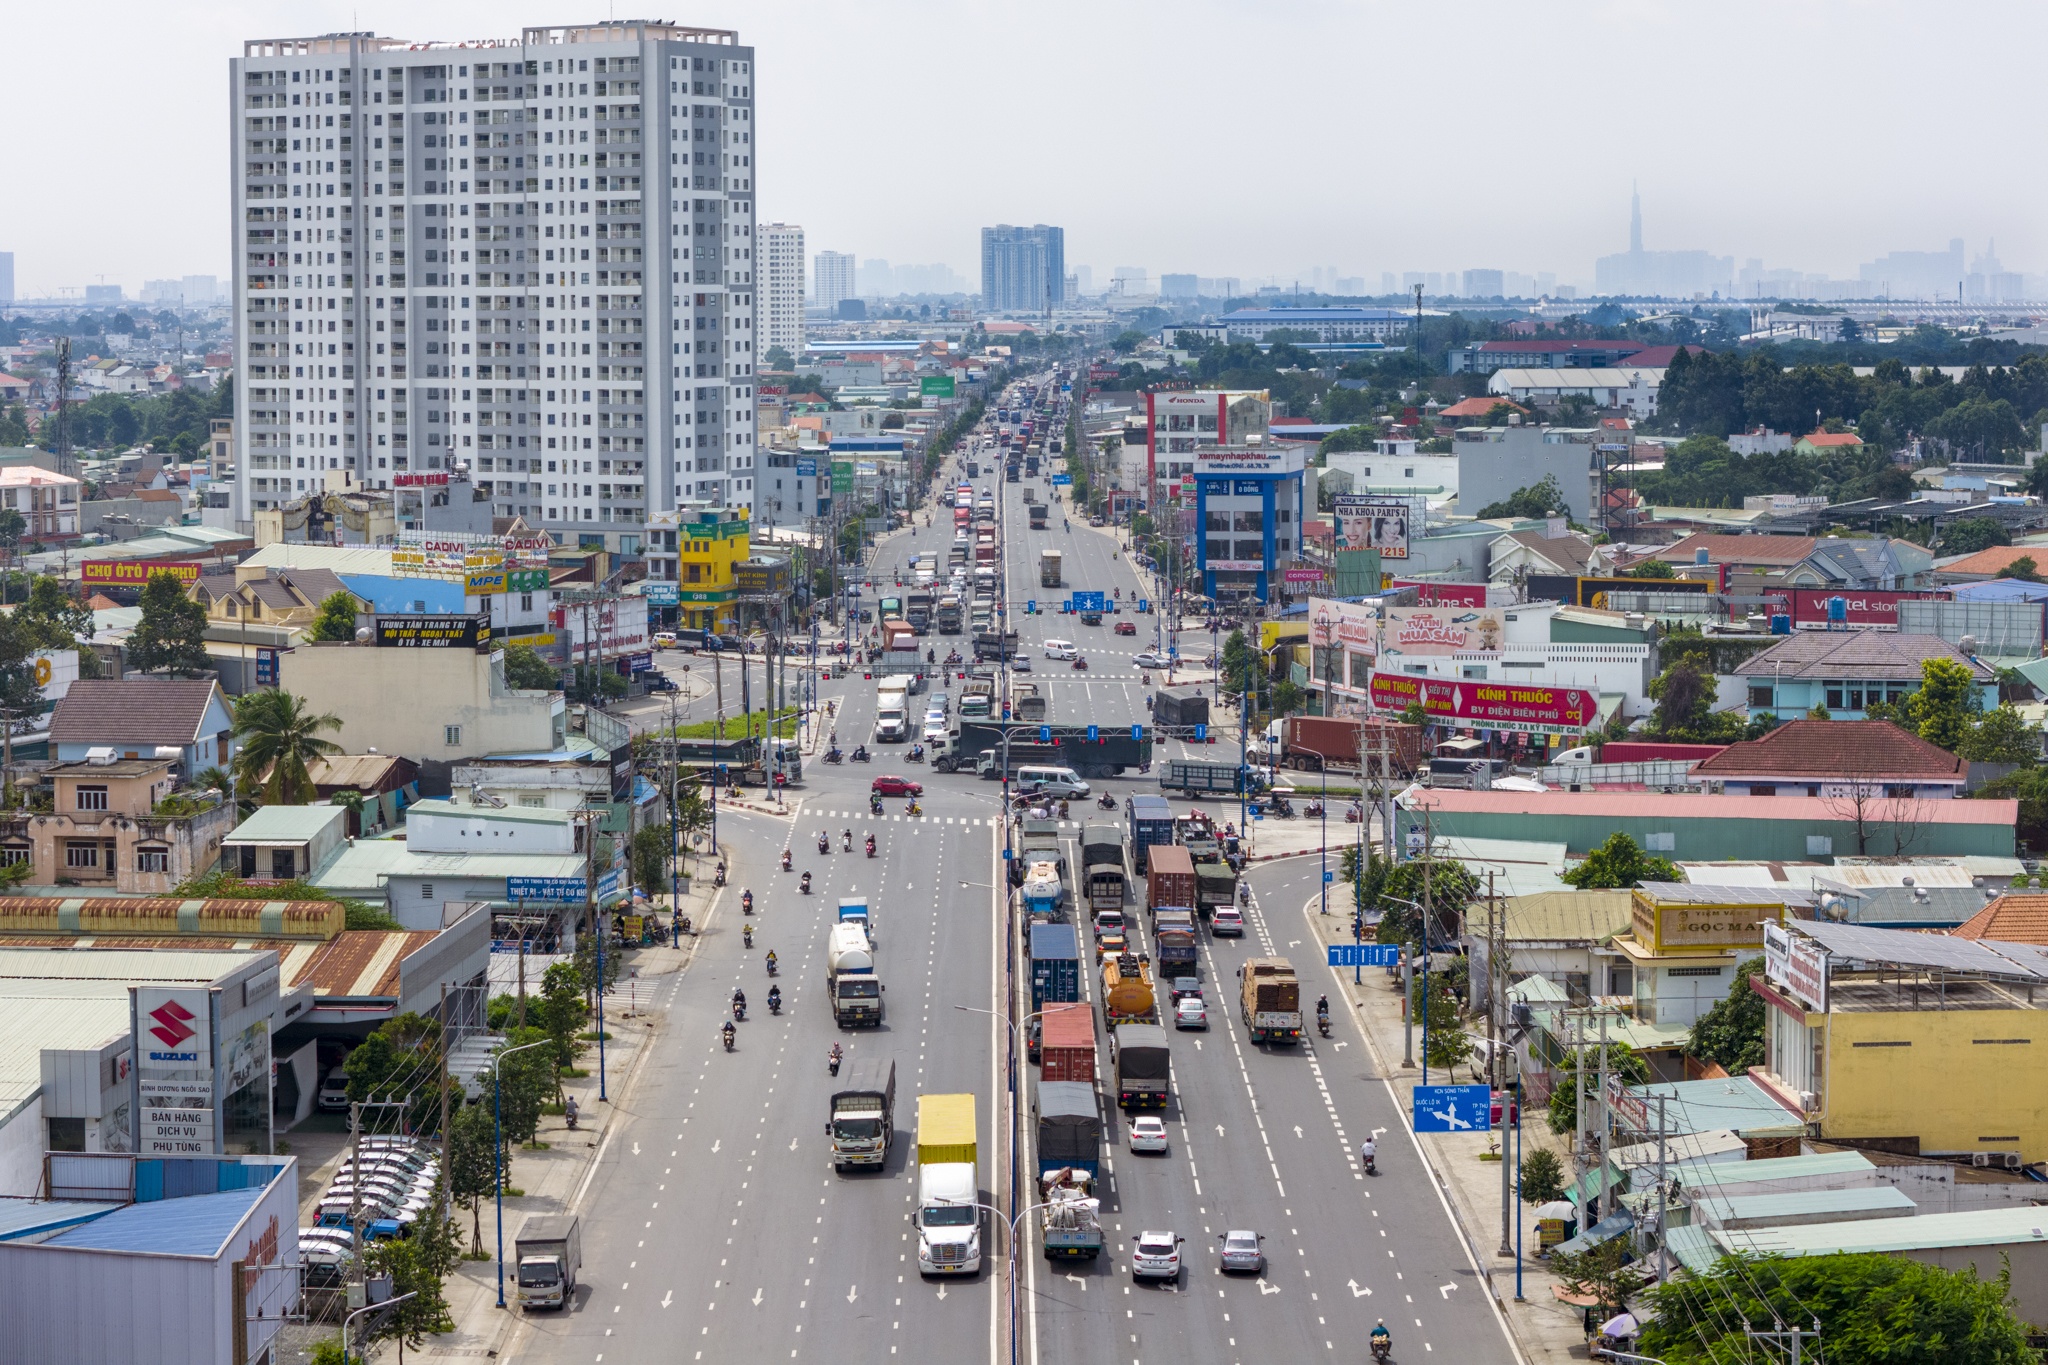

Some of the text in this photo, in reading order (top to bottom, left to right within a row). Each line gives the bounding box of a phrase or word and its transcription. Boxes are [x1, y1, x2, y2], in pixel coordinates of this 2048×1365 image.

[1198, 452, 1281, 461] xemaynhapkhau.com
[1338, 508, 1354, 516] NHA
[1356, 508, 1376, 516] KHOA
[1377, 509, 1400, 517] PARI'S
[425, 541, 464, 552] CADIVI
[505, 538, 548, 550] CADIVI
[86, 564, 112, 580] CHỢ
[116, 562, 142, 578] ÔTÔ
[470, 576, 504, 586] MPE
[380, 620, 466, 629] TRUNG TÂM TRANG TRÍ
[1422, 620, 1441, 628] TIN
[384, 629, 397, 639] NỘI
[398, 629, 416, 638] THẤT
[444, 629, 464, 638] THẤT
[1399, 626, 1466, 644] MUA SẮM
[406, 638, 416, 646] TÔ
[432, 638, 450, 646] MÁY
[258, 651, 271, 660] LASER
[1374, 677, 1417, 694] KÍNH THUỐC
[1428, 686, 1451, 698] SIÊU THỊ
[1476, 687, 1552, 704] KÍNH THUỐC
[1376, 694, 1383, 702] BV
[1438, 699, 1452, 710] KÍNH
[1471, 704, 1558, 720] BV ĐIỆN BIÊN PHỦ
[1471, 720, 1495, 728] PHÒNG
[1497, 721, 1516, 730] KHÚC
[1518, 724, 1528, 732] XẠ
[510, 885, 528, 896] THIẾT
[1696, 910, 1720, 918] TIỆM
[1677, 923, 1724, 933] NGỌC
[150, 1052, 198, 1062] SUZUKI
[182, 1084, 196, 1092] NGÔI
[152, 1110, 202, 1122] BÁN HÀNG
[158, 1126, 196, 1138] DỊCH VỤ
[154, 1140, 202, 1154] PHỤ TÙNG
